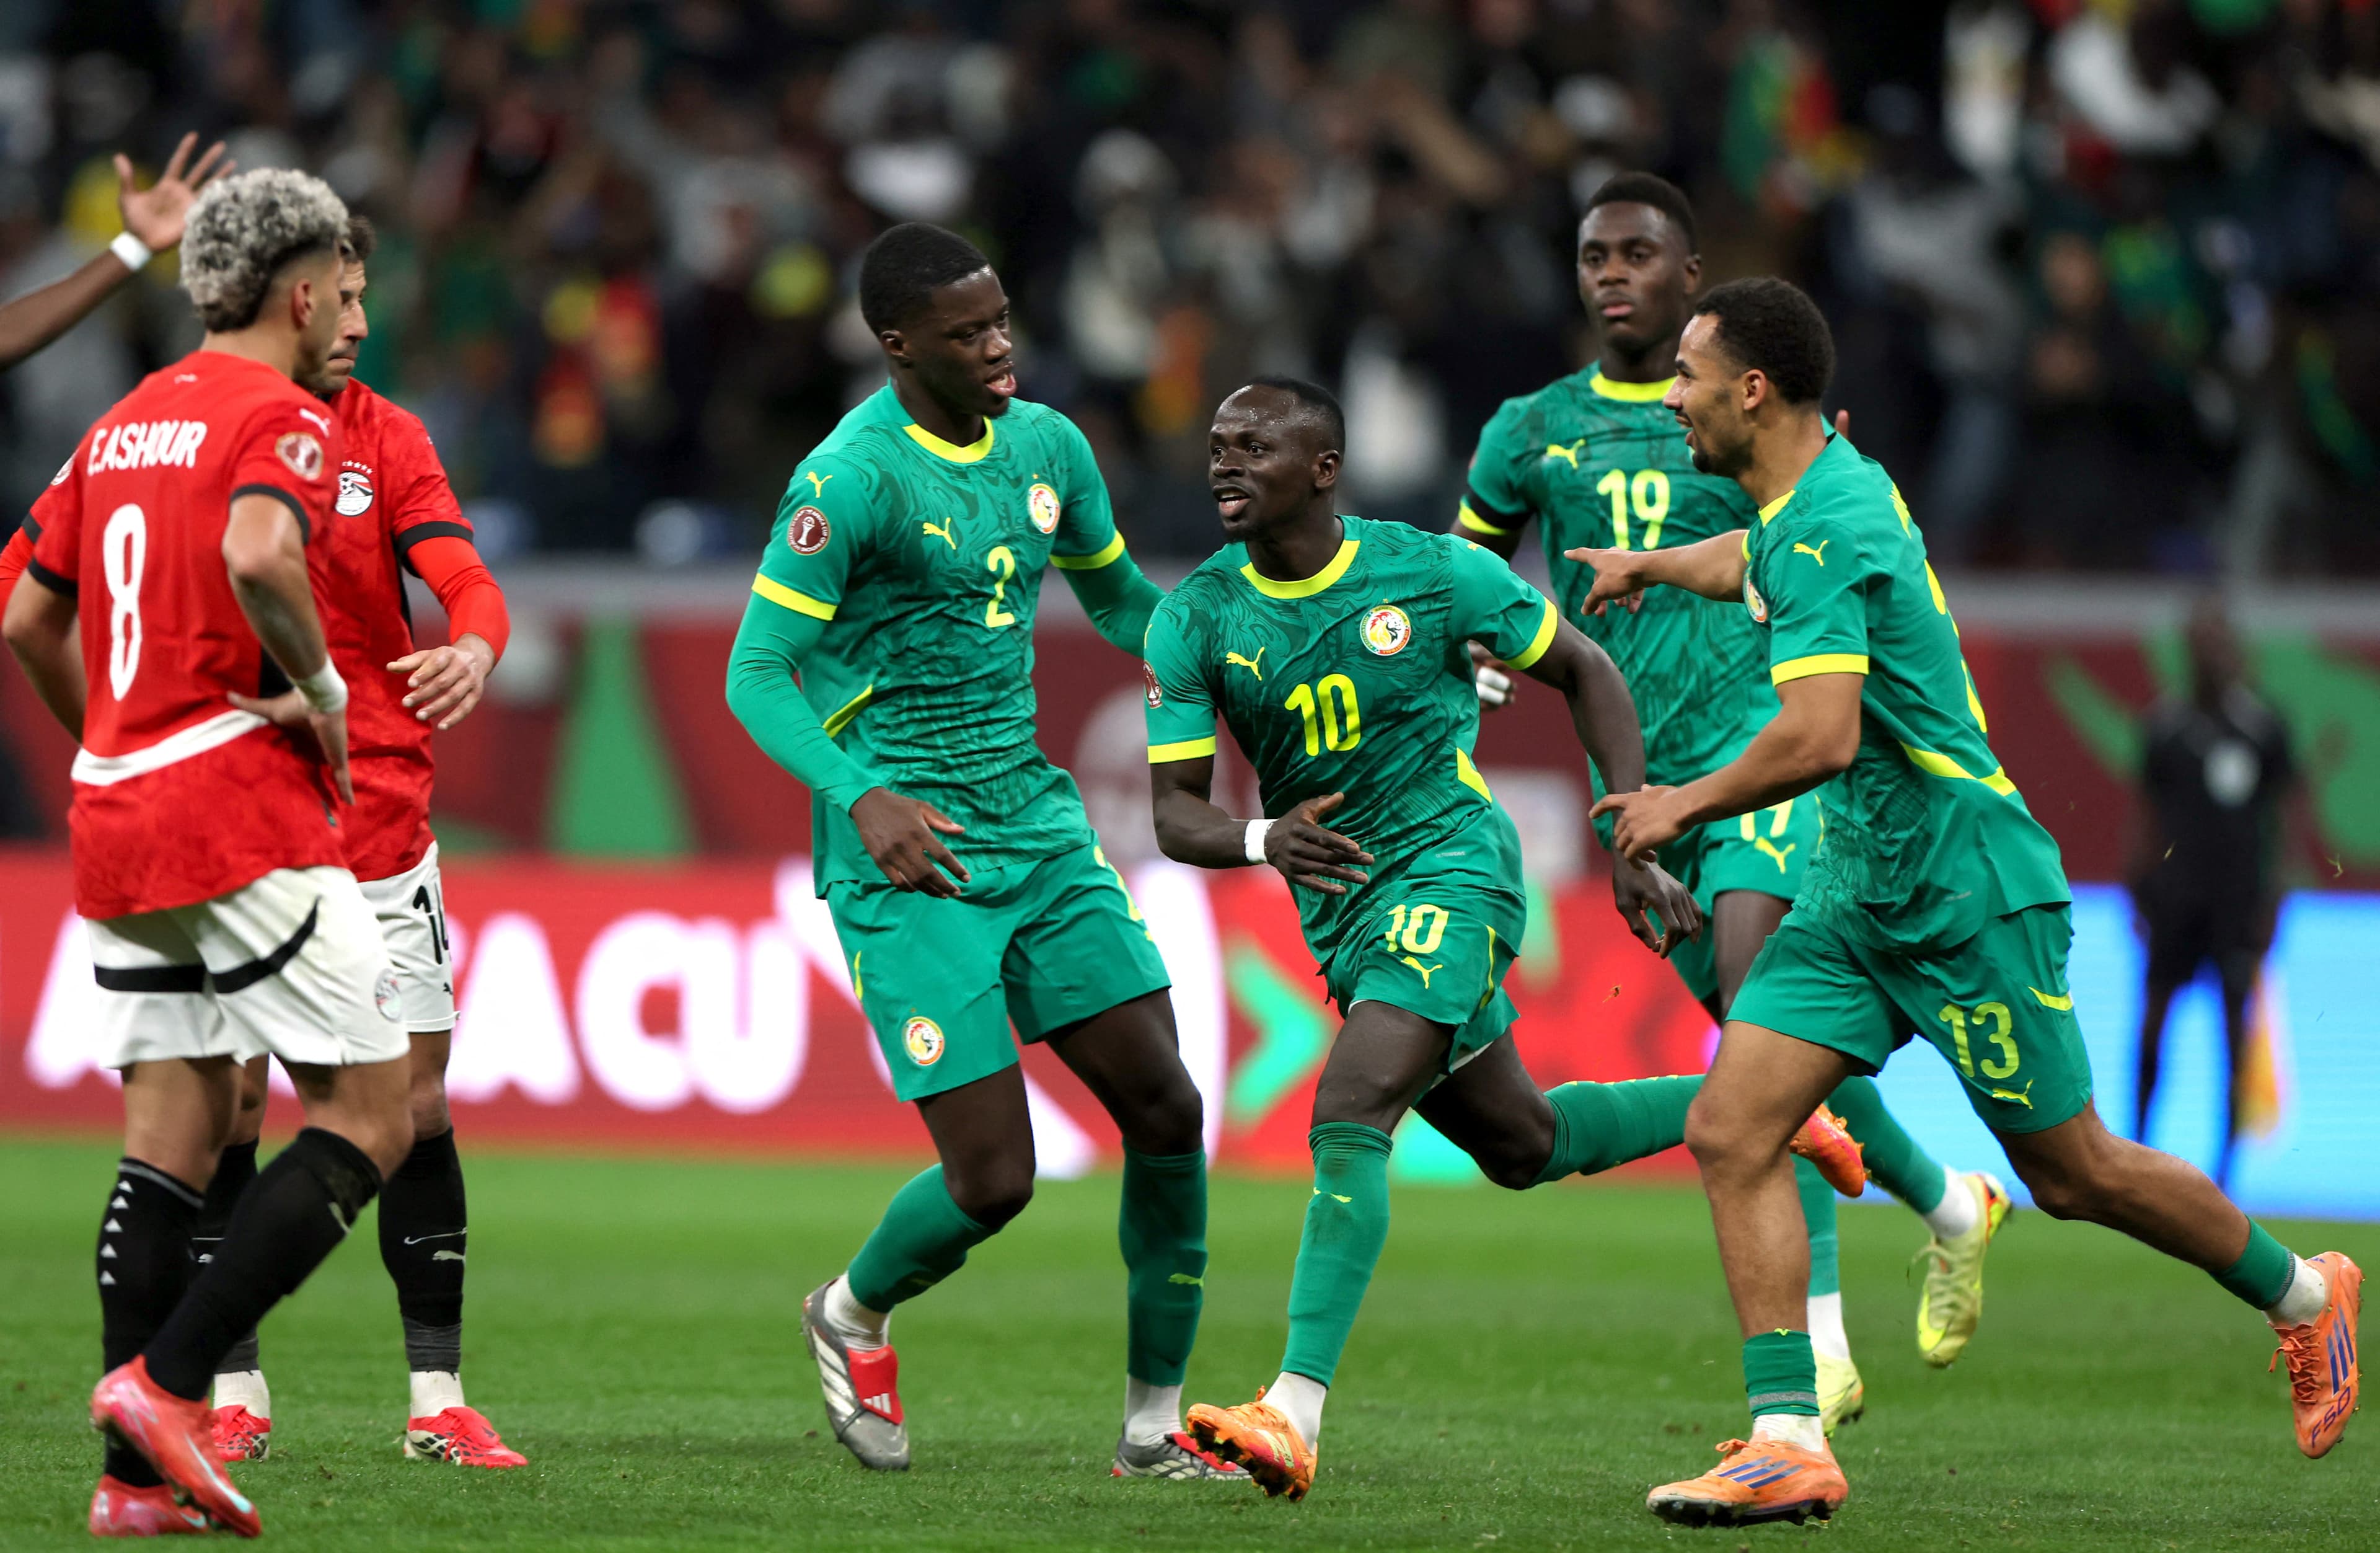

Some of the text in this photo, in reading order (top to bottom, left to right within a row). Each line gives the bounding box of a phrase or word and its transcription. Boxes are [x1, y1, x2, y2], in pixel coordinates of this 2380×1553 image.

[1597, 468, 1670, 551] 19
[103, 503, 146, 702] 8
[985, 546, 1015, 627] 2
[1284, 673, 1361, 756] 10
[1384, 903, 1450, 954] 10
[1939, 1002, 2019, 1079] 13
